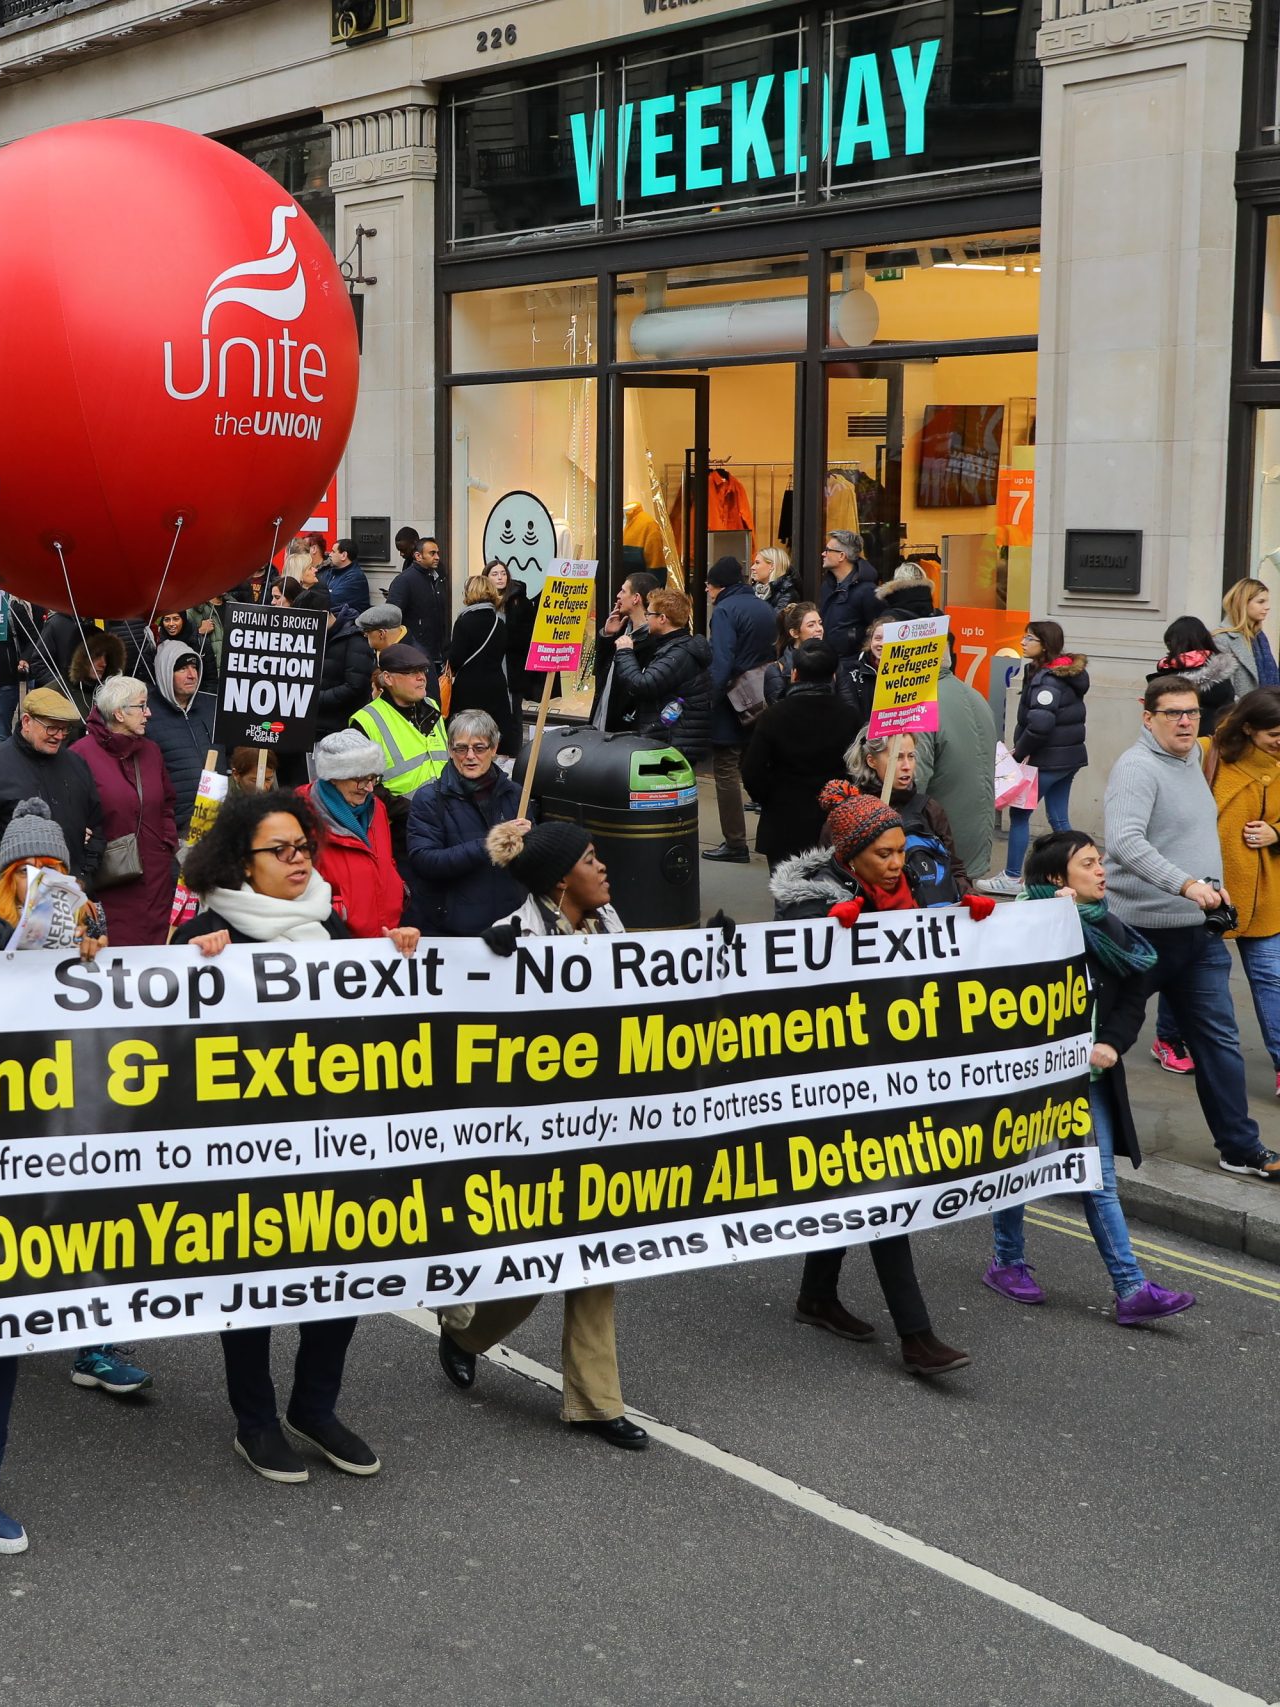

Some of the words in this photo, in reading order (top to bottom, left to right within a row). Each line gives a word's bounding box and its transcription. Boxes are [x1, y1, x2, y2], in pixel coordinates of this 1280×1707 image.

[476, 23, 518, 52] 226
[570, 39, 941, 206] WEEKDAY
[163, 328, 327, 403] unite
[1080, 554, 1128, 569] WEEKDAY
[551, 580, 589, 597] Migrants
[543, 595, 552, 609] &
[553, 598, 589, 612] refugees
[232, 610, 268, 627] BRITAIN
[270, 614, 280, 628] IS
[282, 615, 319, 631] BROKEN
[546, 613, 581, 625] welcome
[911, 623, 928, 631] STAND
[229, 628, 317, 655] GENERAL
[552, 627, 570, 640] here
[961, 627, 973, 637] up
[975, 627, 984, 636] to
[890, 641, 938, 660] Migrants
[227, 652, 315, 679] ELECTION
[881, 662, 889, 675] &
[893, 656, 938, 674] refugees
[885, 673, 931, 690] welcome
[223, 677, 315, 719] NOW
[894, 691, 917, 704] here
[880, 719, 892, 728] not
[892, 714, 920, 727] migrants
[53, 956, 225, 1018] Stop
[252, 947, 444, 1004] Brexit
[515, 945, 592, 996] No
[611, 933, 748, 989] Racist
[765, 926, 834, 974] EU
[850, 914, 961, 966] Exit!
[107, 1039, 169, 1106] &
[195, 1022, 433, 1102] Extend
[456, 1023, 600, 1085] Free
[619, 991, 870, 1076] Movement
[887, 982, 940, 1042] of
[958, 965, 1089, 1037] People
[155, 1139, 192, 1170] to
[206, 1135, 302, 1167] move,
[314, 1124, 376, 1161] live,
[386, 1121, 445, 1153] love,
[453, 1114, 530, 1147] work,
[540, 1105, 618, 1142] study:
[628, 1104, 663, 1132] No
[672, 1100, 697, 1128] to
[703, 1089, 783, 1123] Fortress
[791, 1075, 879, 1110] Europe,
[886, 1071, 919, 1097] No
[927, 1067, 952, 1092] to
[960, 1055, 1040, 1088] Fortress
[464, 1167, 564, 1236] Shut
[578, 1162, 693, 1222] Down
[703, 1141, 778, 1204] ALL
[788, 1115, 984, 1192] Detention
[992, 1096, 1093, 1160] Centres
[127, 1287, 205, 1323] for
[220, 1269, 407, 1314] Justice
[426, 1263, 482, 1297] By
[494, 1251, 564, 1285] Any
[577, 1231, 709, 1271] Means
[721, 1197, 923, 1250] Necessary
[932, 1152, 1088, 1220] @followmfj
